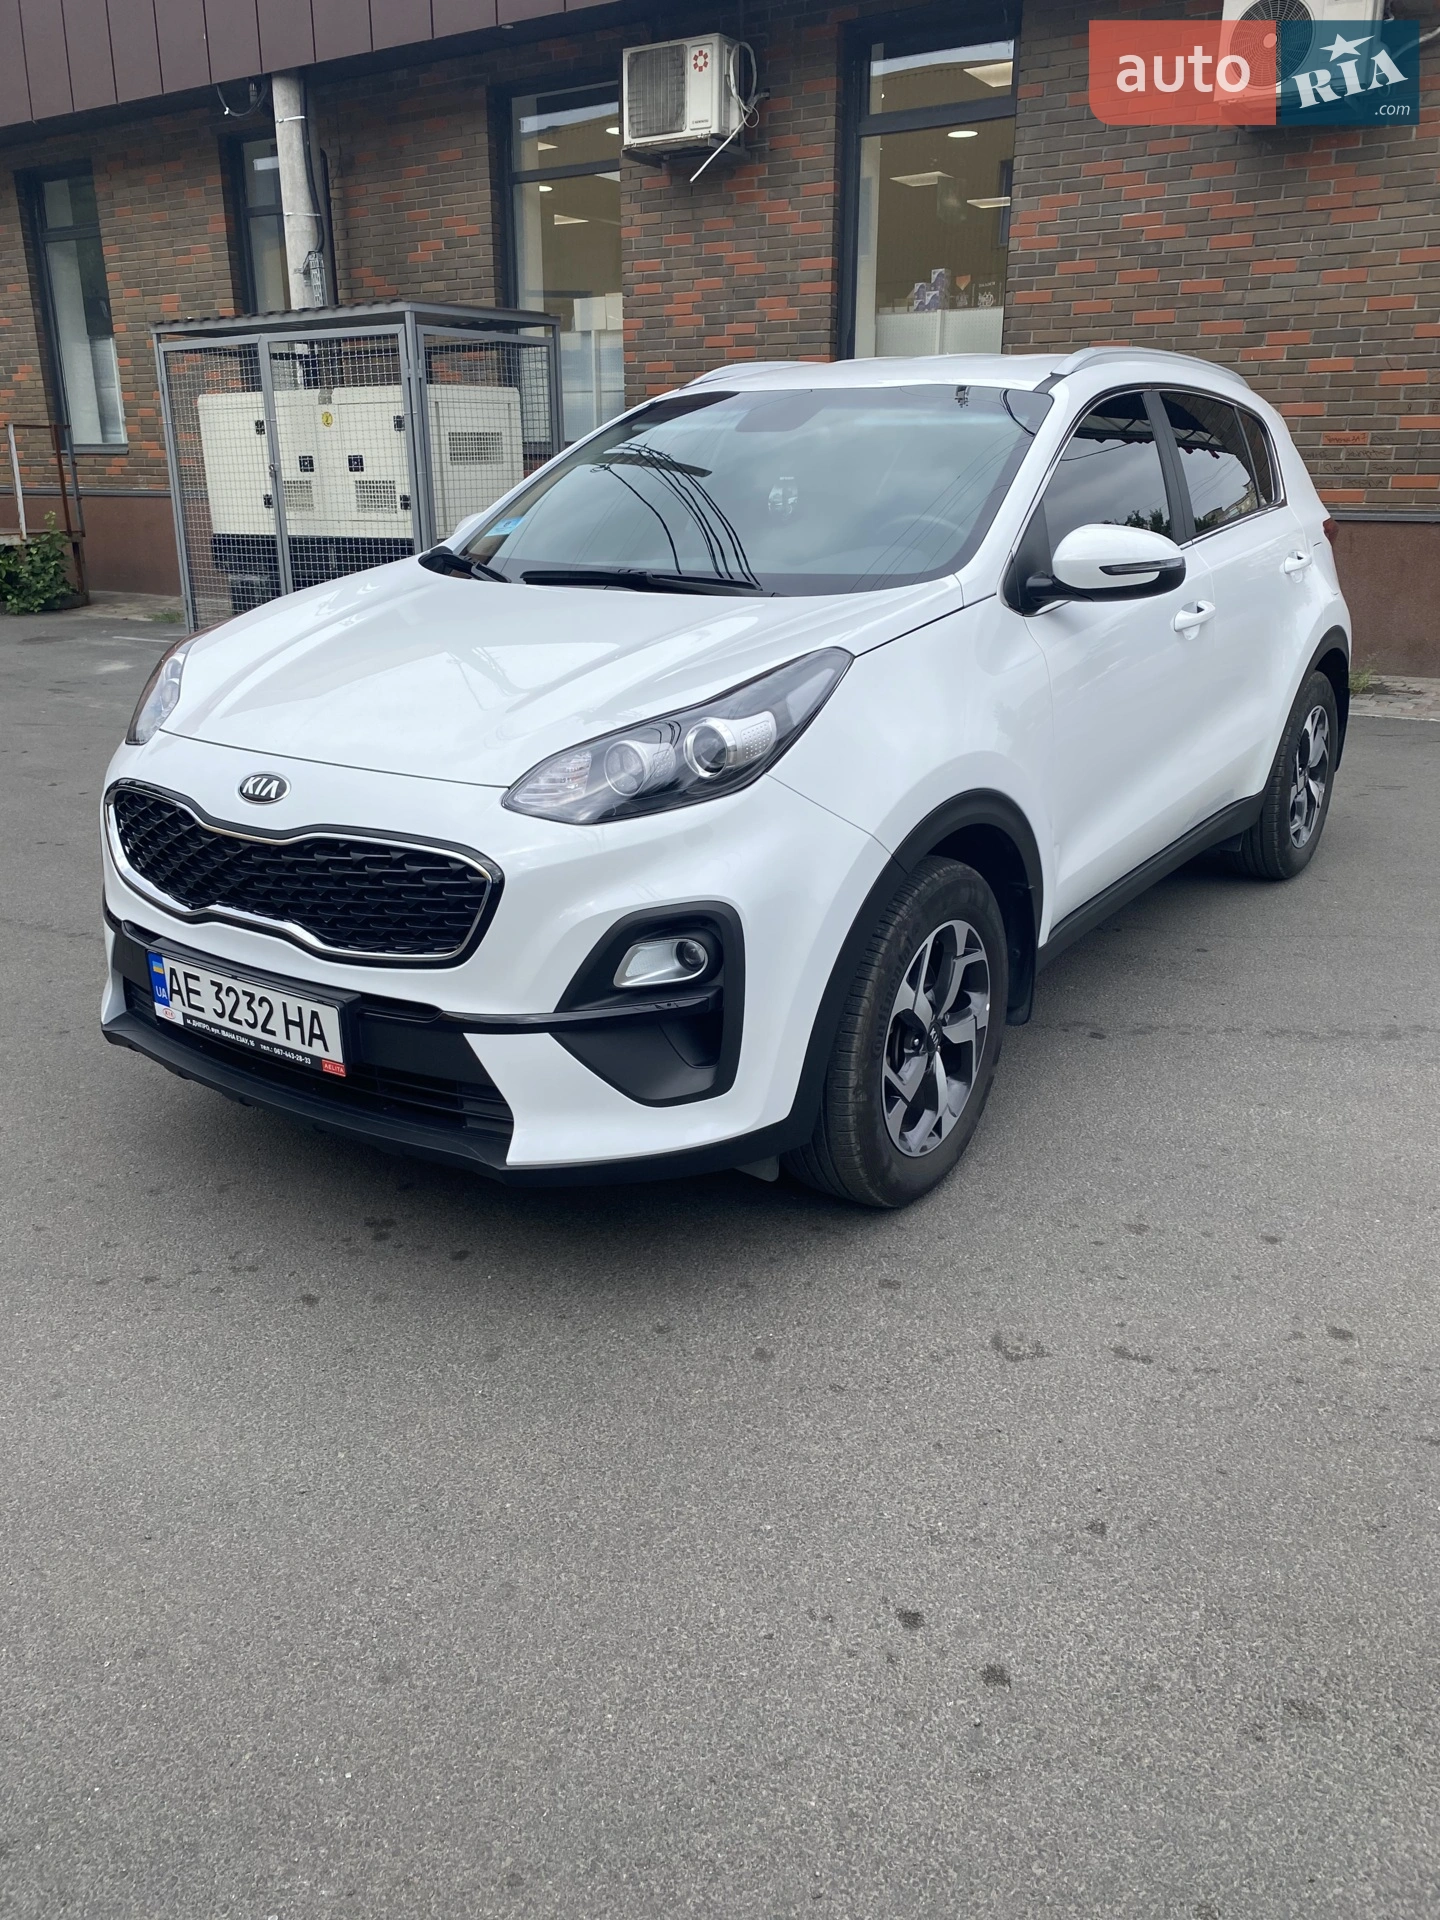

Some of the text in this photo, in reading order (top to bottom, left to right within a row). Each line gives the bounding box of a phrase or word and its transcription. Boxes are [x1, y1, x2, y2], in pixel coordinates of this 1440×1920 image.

[242, 776, 280, 798] KIA
[155, 985, 168, 1000] UA
[169, 966, 330, 1053] AE 3232 HA
[323, 1062, 346, 1074] AELITA
